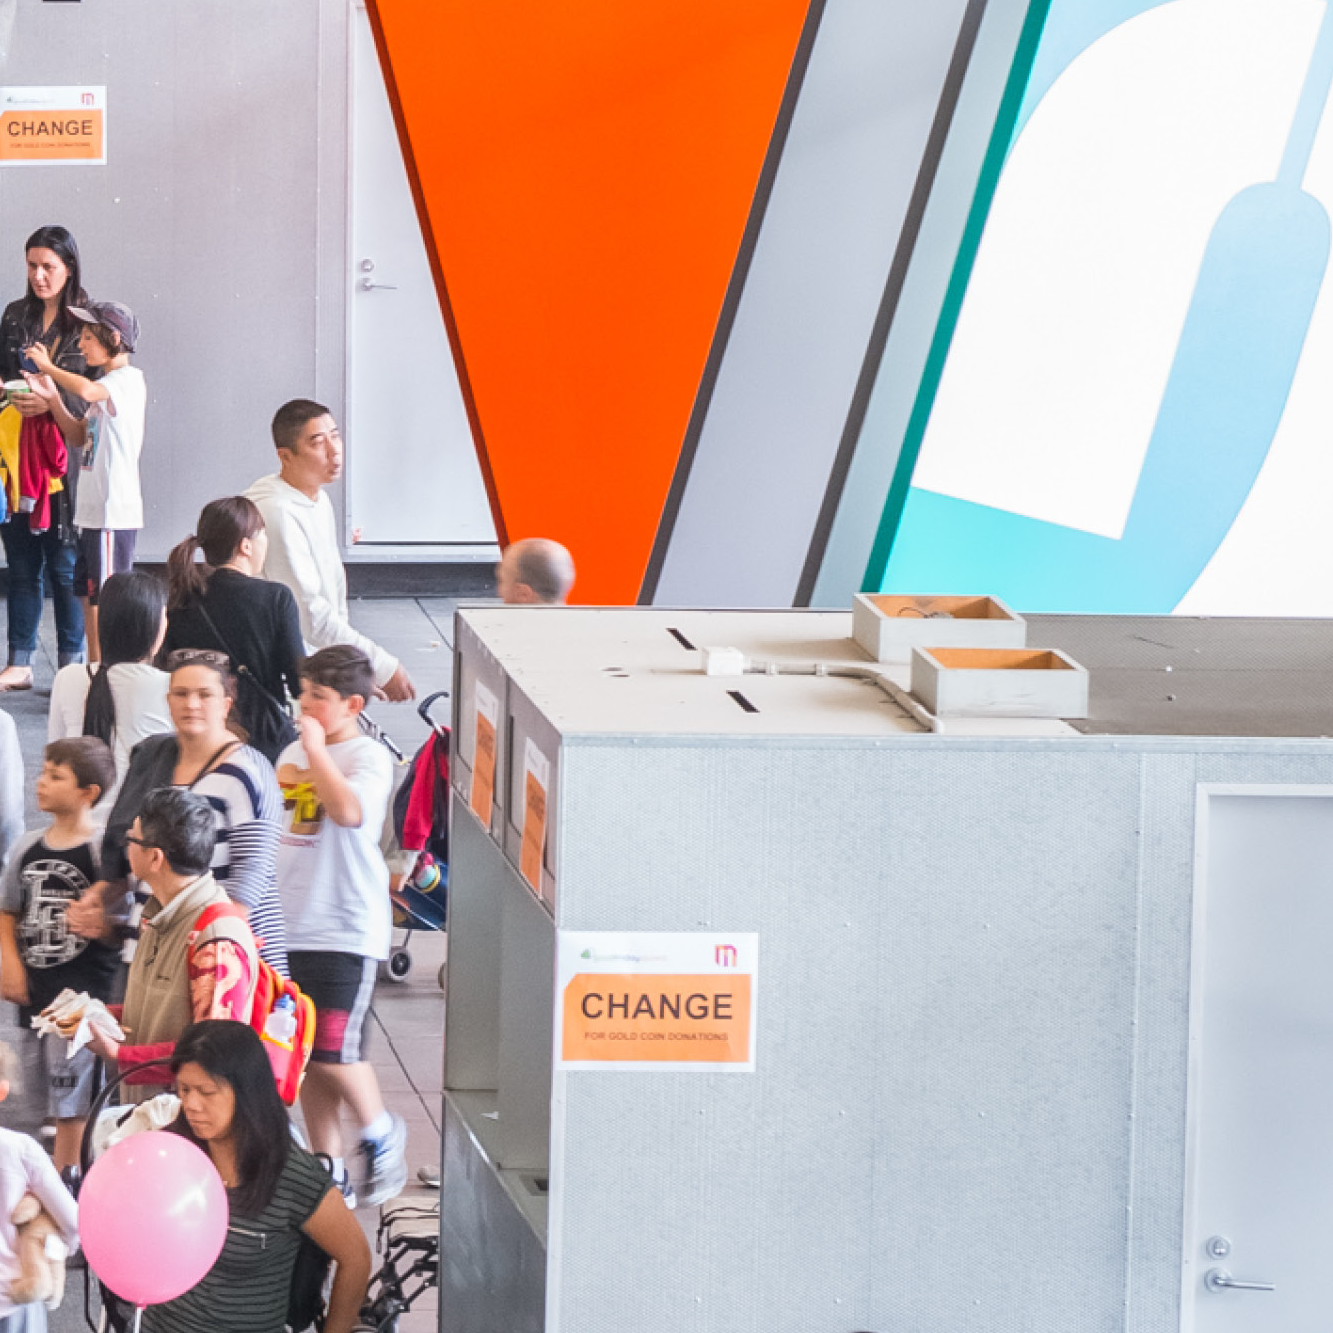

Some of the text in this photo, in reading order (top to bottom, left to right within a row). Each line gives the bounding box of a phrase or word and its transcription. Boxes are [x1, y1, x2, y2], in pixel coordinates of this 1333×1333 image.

[7, 119, 93, 136] CHANGE
[581, 992, 733, 1020] CHANGE
[584, 1032, 729, 1041] FOR GOLD COIN DONATIONS
